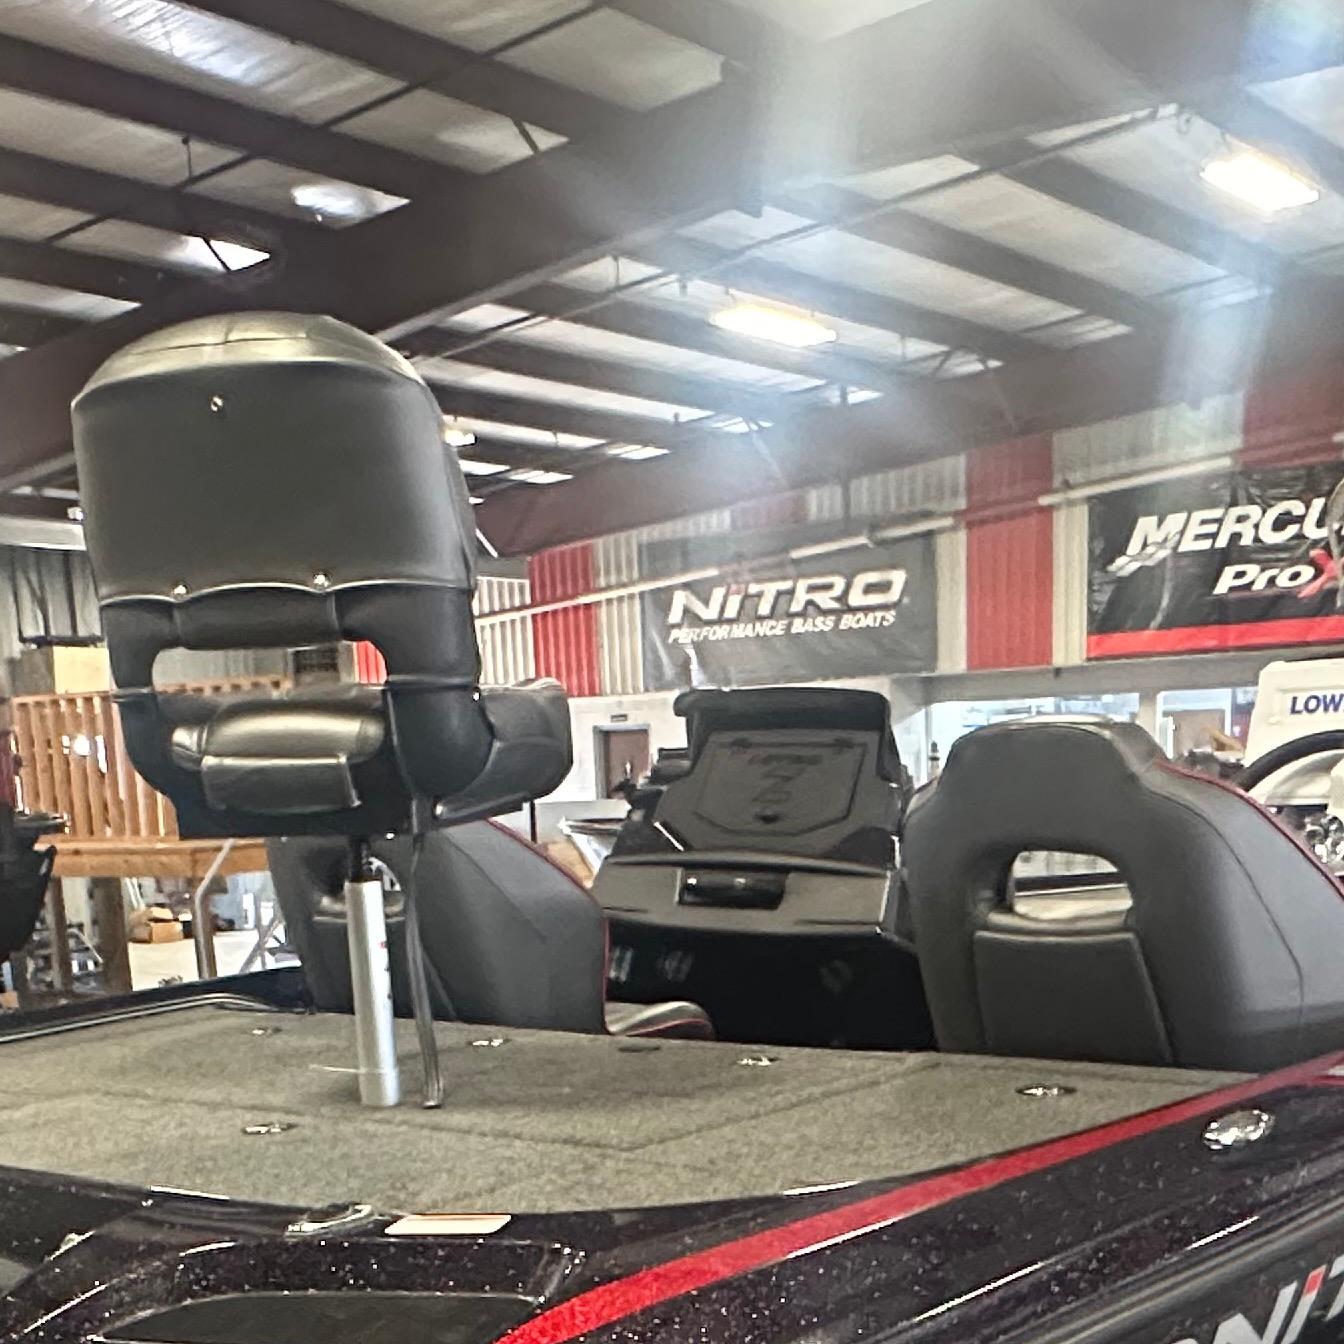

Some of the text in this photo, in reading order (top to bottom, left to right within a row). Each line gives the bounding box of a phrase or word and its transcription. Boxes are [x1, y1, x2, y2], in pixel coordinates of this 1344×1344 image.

[667, 568, 907, 625] NITRO
[668, 609, 896, 644] PERFORMANCE BASS BOATS
